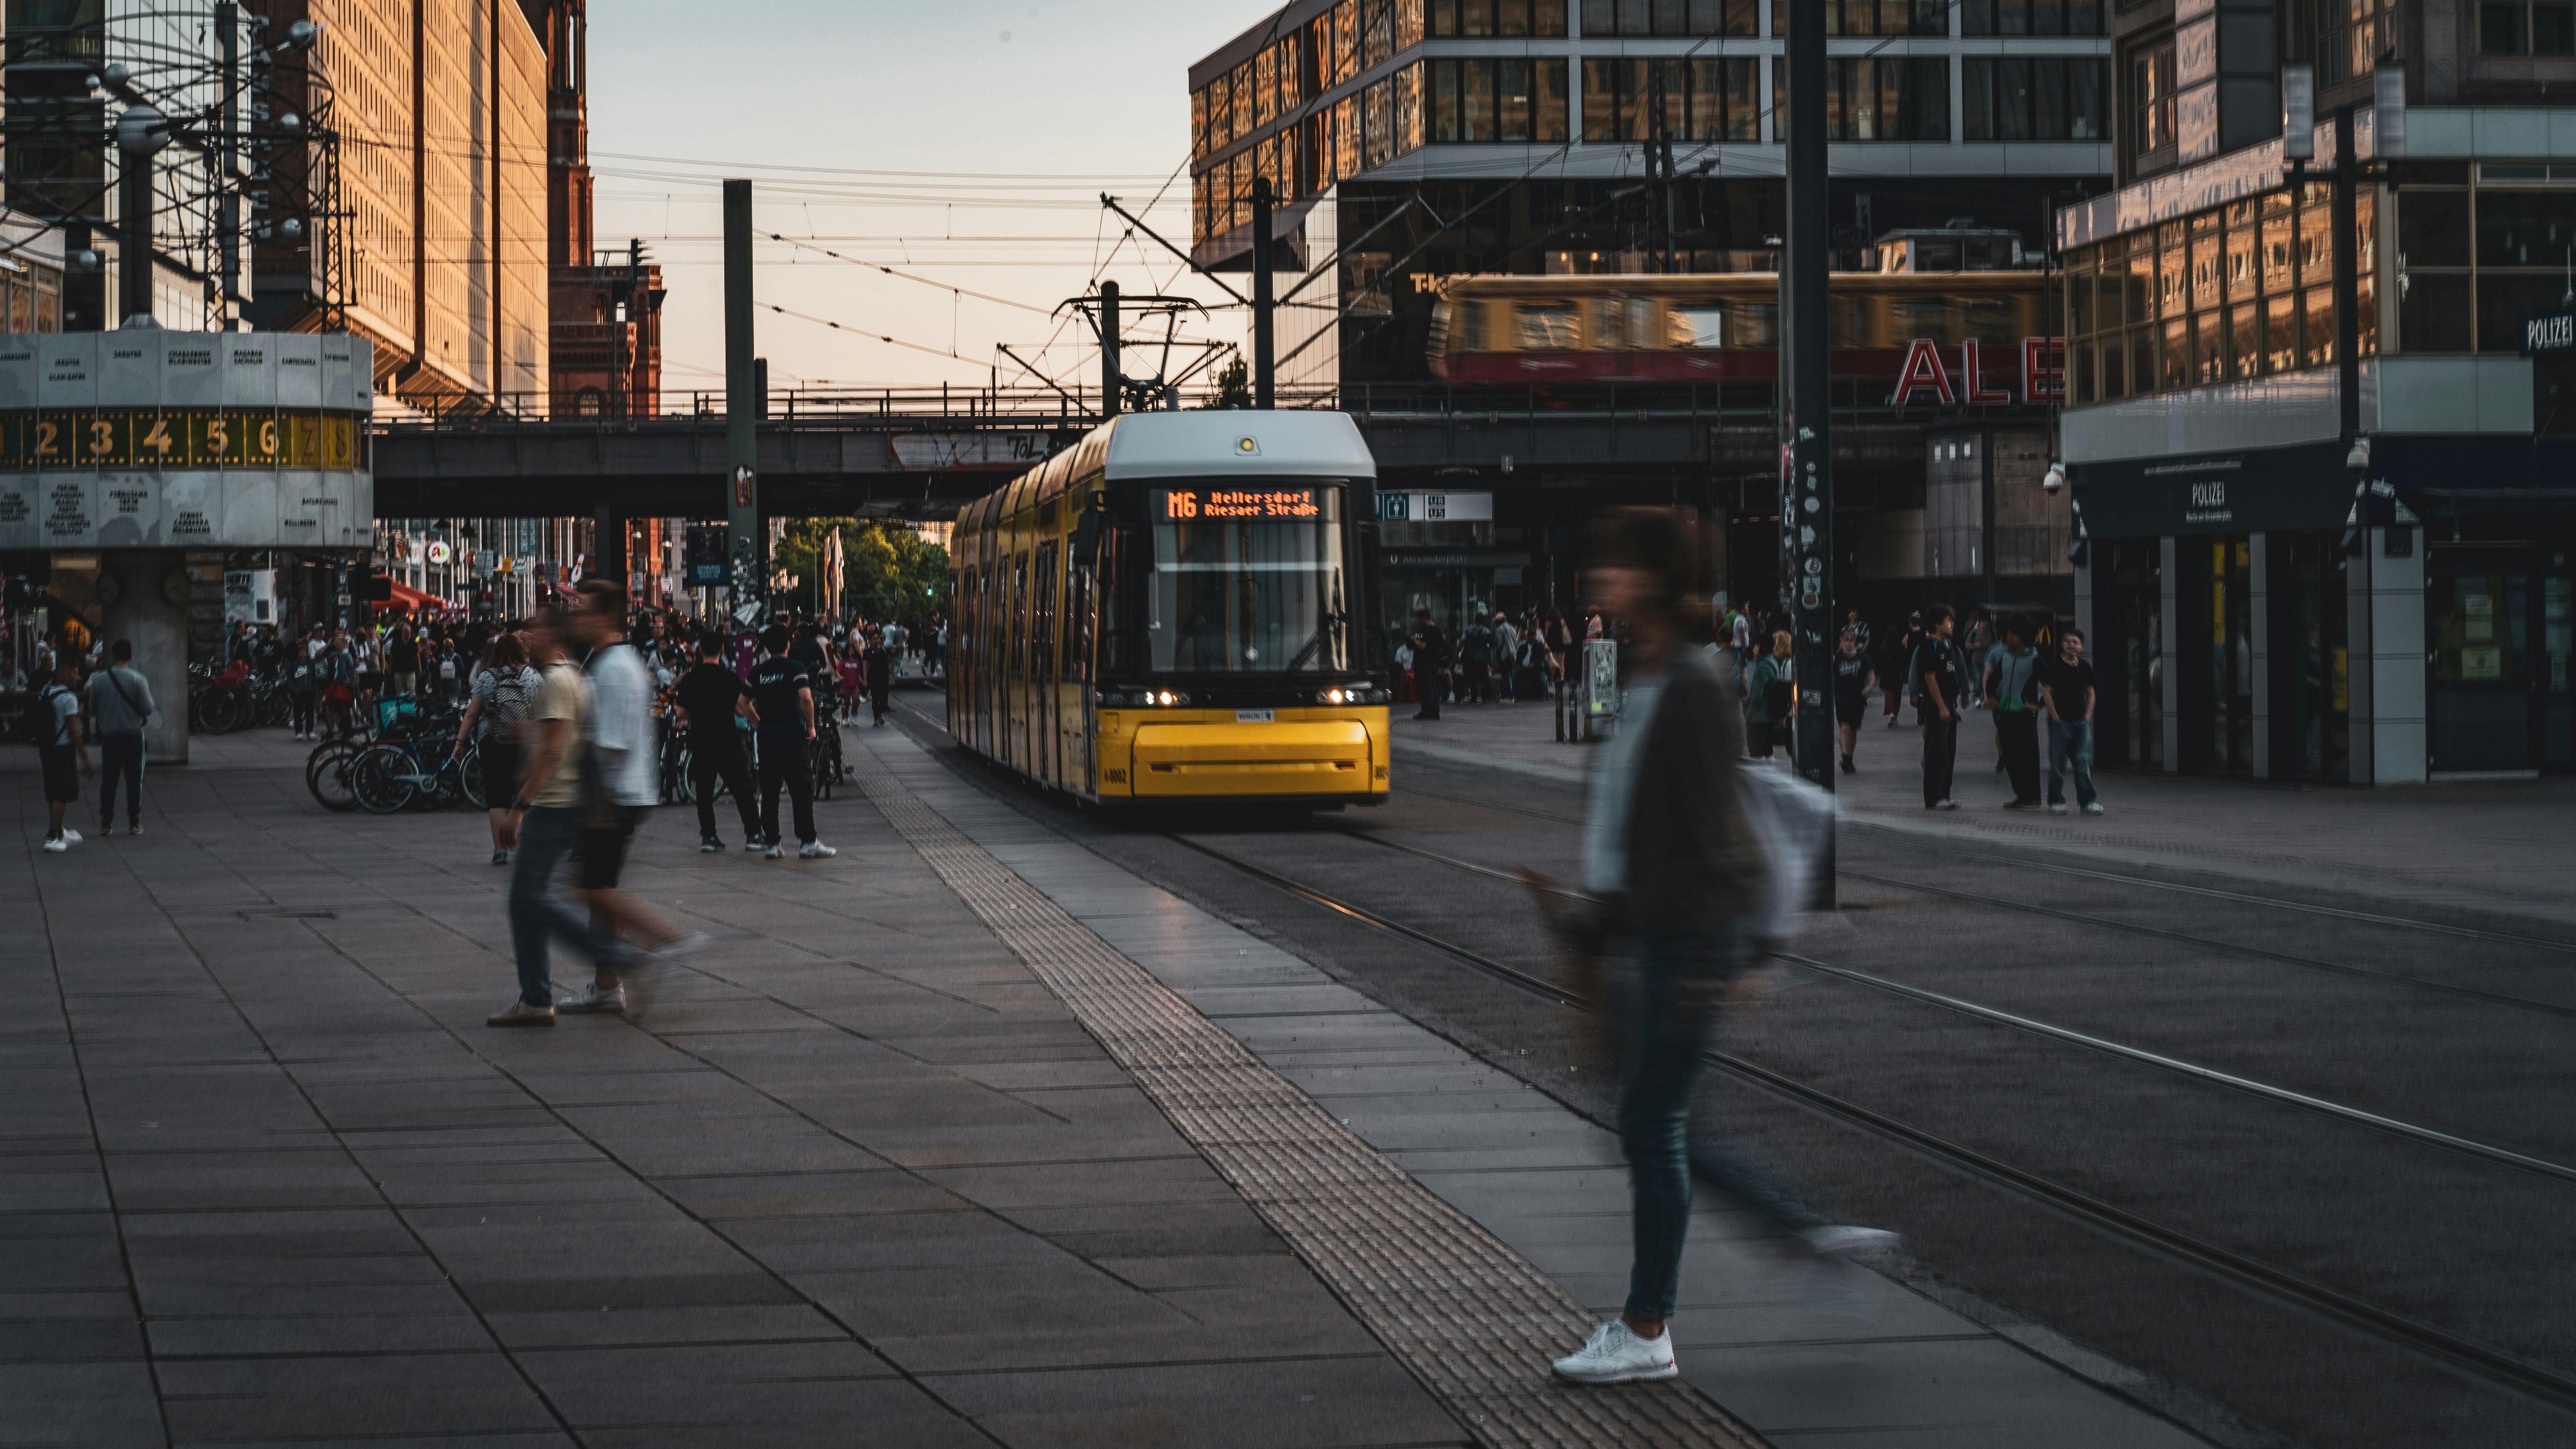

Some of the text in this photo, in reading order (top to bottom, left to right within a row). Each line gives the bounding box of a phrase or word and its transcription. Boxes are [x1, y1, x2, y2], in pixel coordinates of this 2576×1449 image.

[2528, 316, 2573, 350] POLIZEI
[34, 422, 58, 456] 2
[90, 421, 112, 454] 3
[143, 420, 172, 454] 4
[207, 420, 228, 454] 5
[259, 420, 279, 456] 6
[1211, 491, 1310, 504] Hellersdorf
[1431, 495, 1443, 505] U8
[2193, 481, 2224, 507] POLIZEI
[1168, 492, 1197, 518] M6
[1204, 503, 1319, 516] Riesaer Straße
[1431, 508, 1443, 518] U5
[1403, 554, 1467, 565] Alexanderplatz
